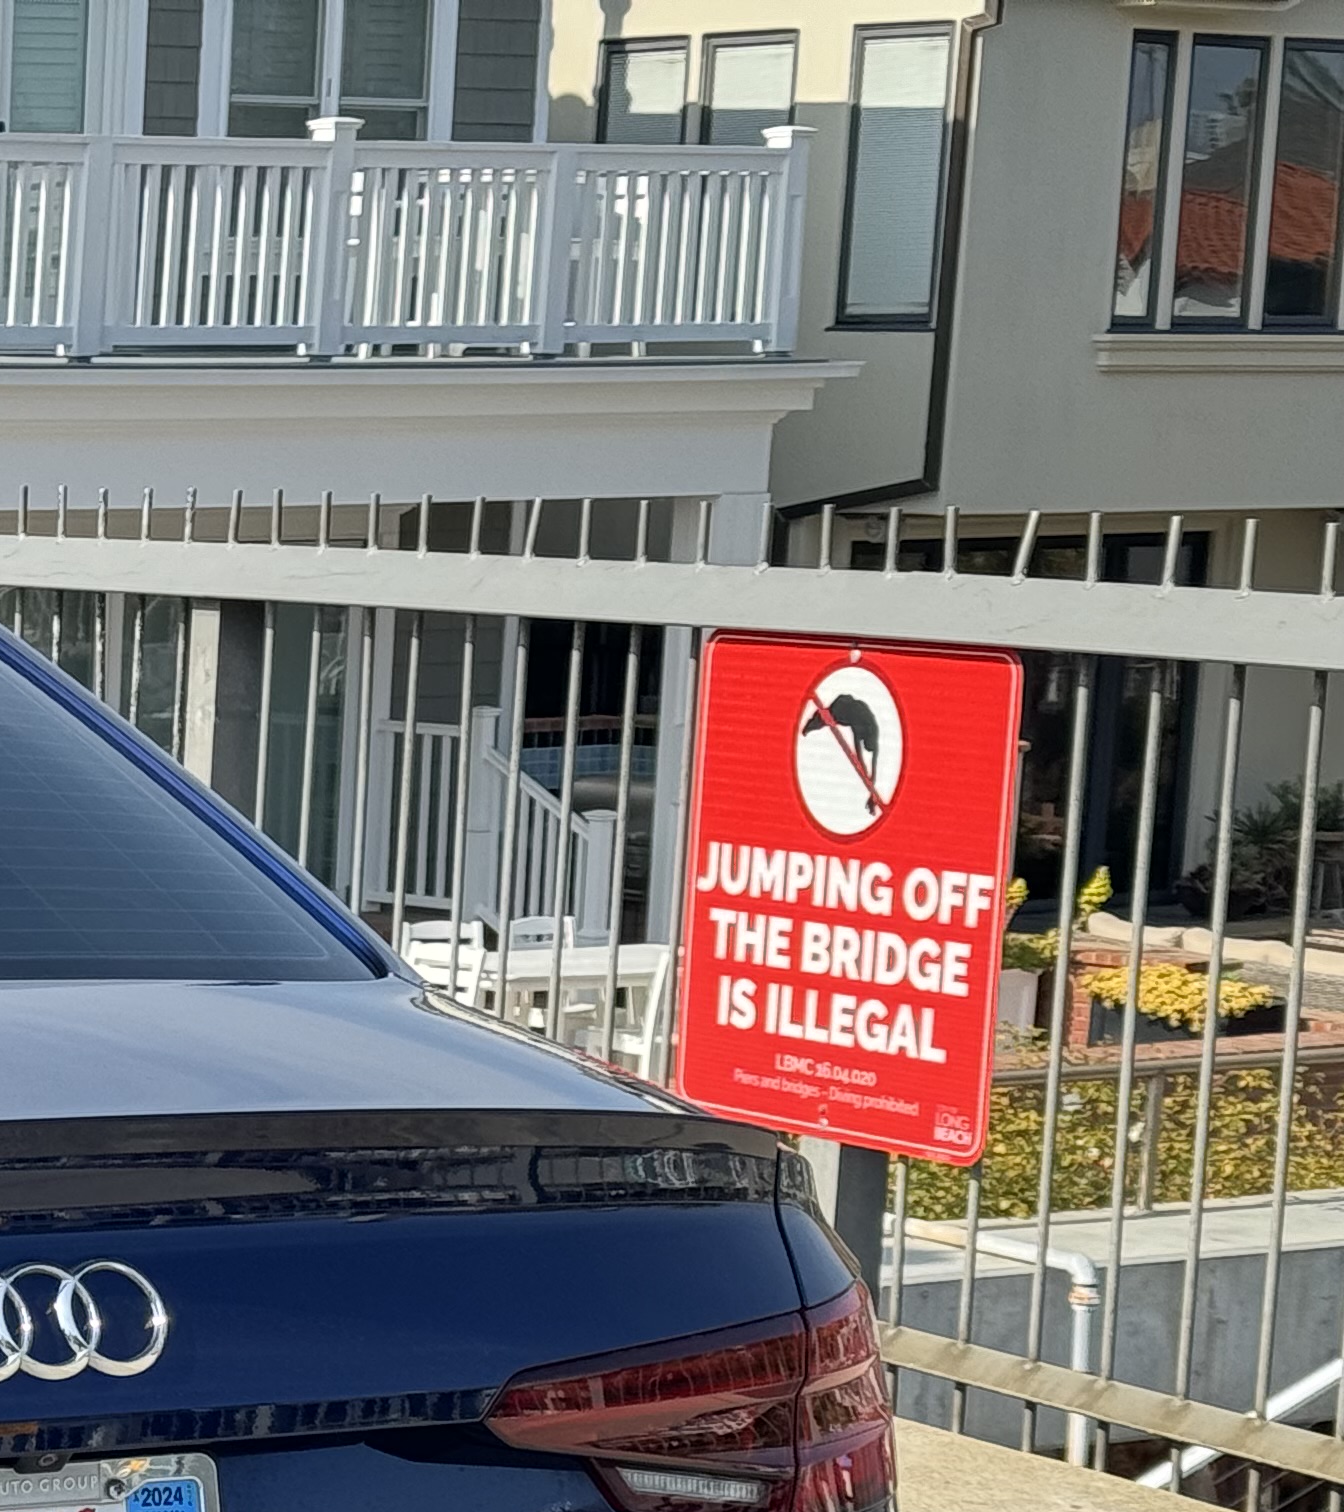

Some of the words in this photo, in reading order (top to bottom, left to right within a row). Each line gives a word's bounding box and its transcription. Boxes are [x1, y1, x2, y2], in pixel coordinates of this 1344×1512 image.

[697, 841, 893, 916] JUMPING
[902, 867, 995, 929] OFF
[709, 907, 793, 970] THE
[800, 920, 972, 997] BRIDGE
[716, 975, 757, 1030] IS
[764, 982, 947, 1064] ILLEGAL
[775, 1053, 814, 1076] LBMC
[934, 1111, 971, 1130] LONG
[933, 1126, 973, 1145] BEACH
[40, 1475, 98, 1493] GROUP
[140, 1486, 184, 1508] 2024
